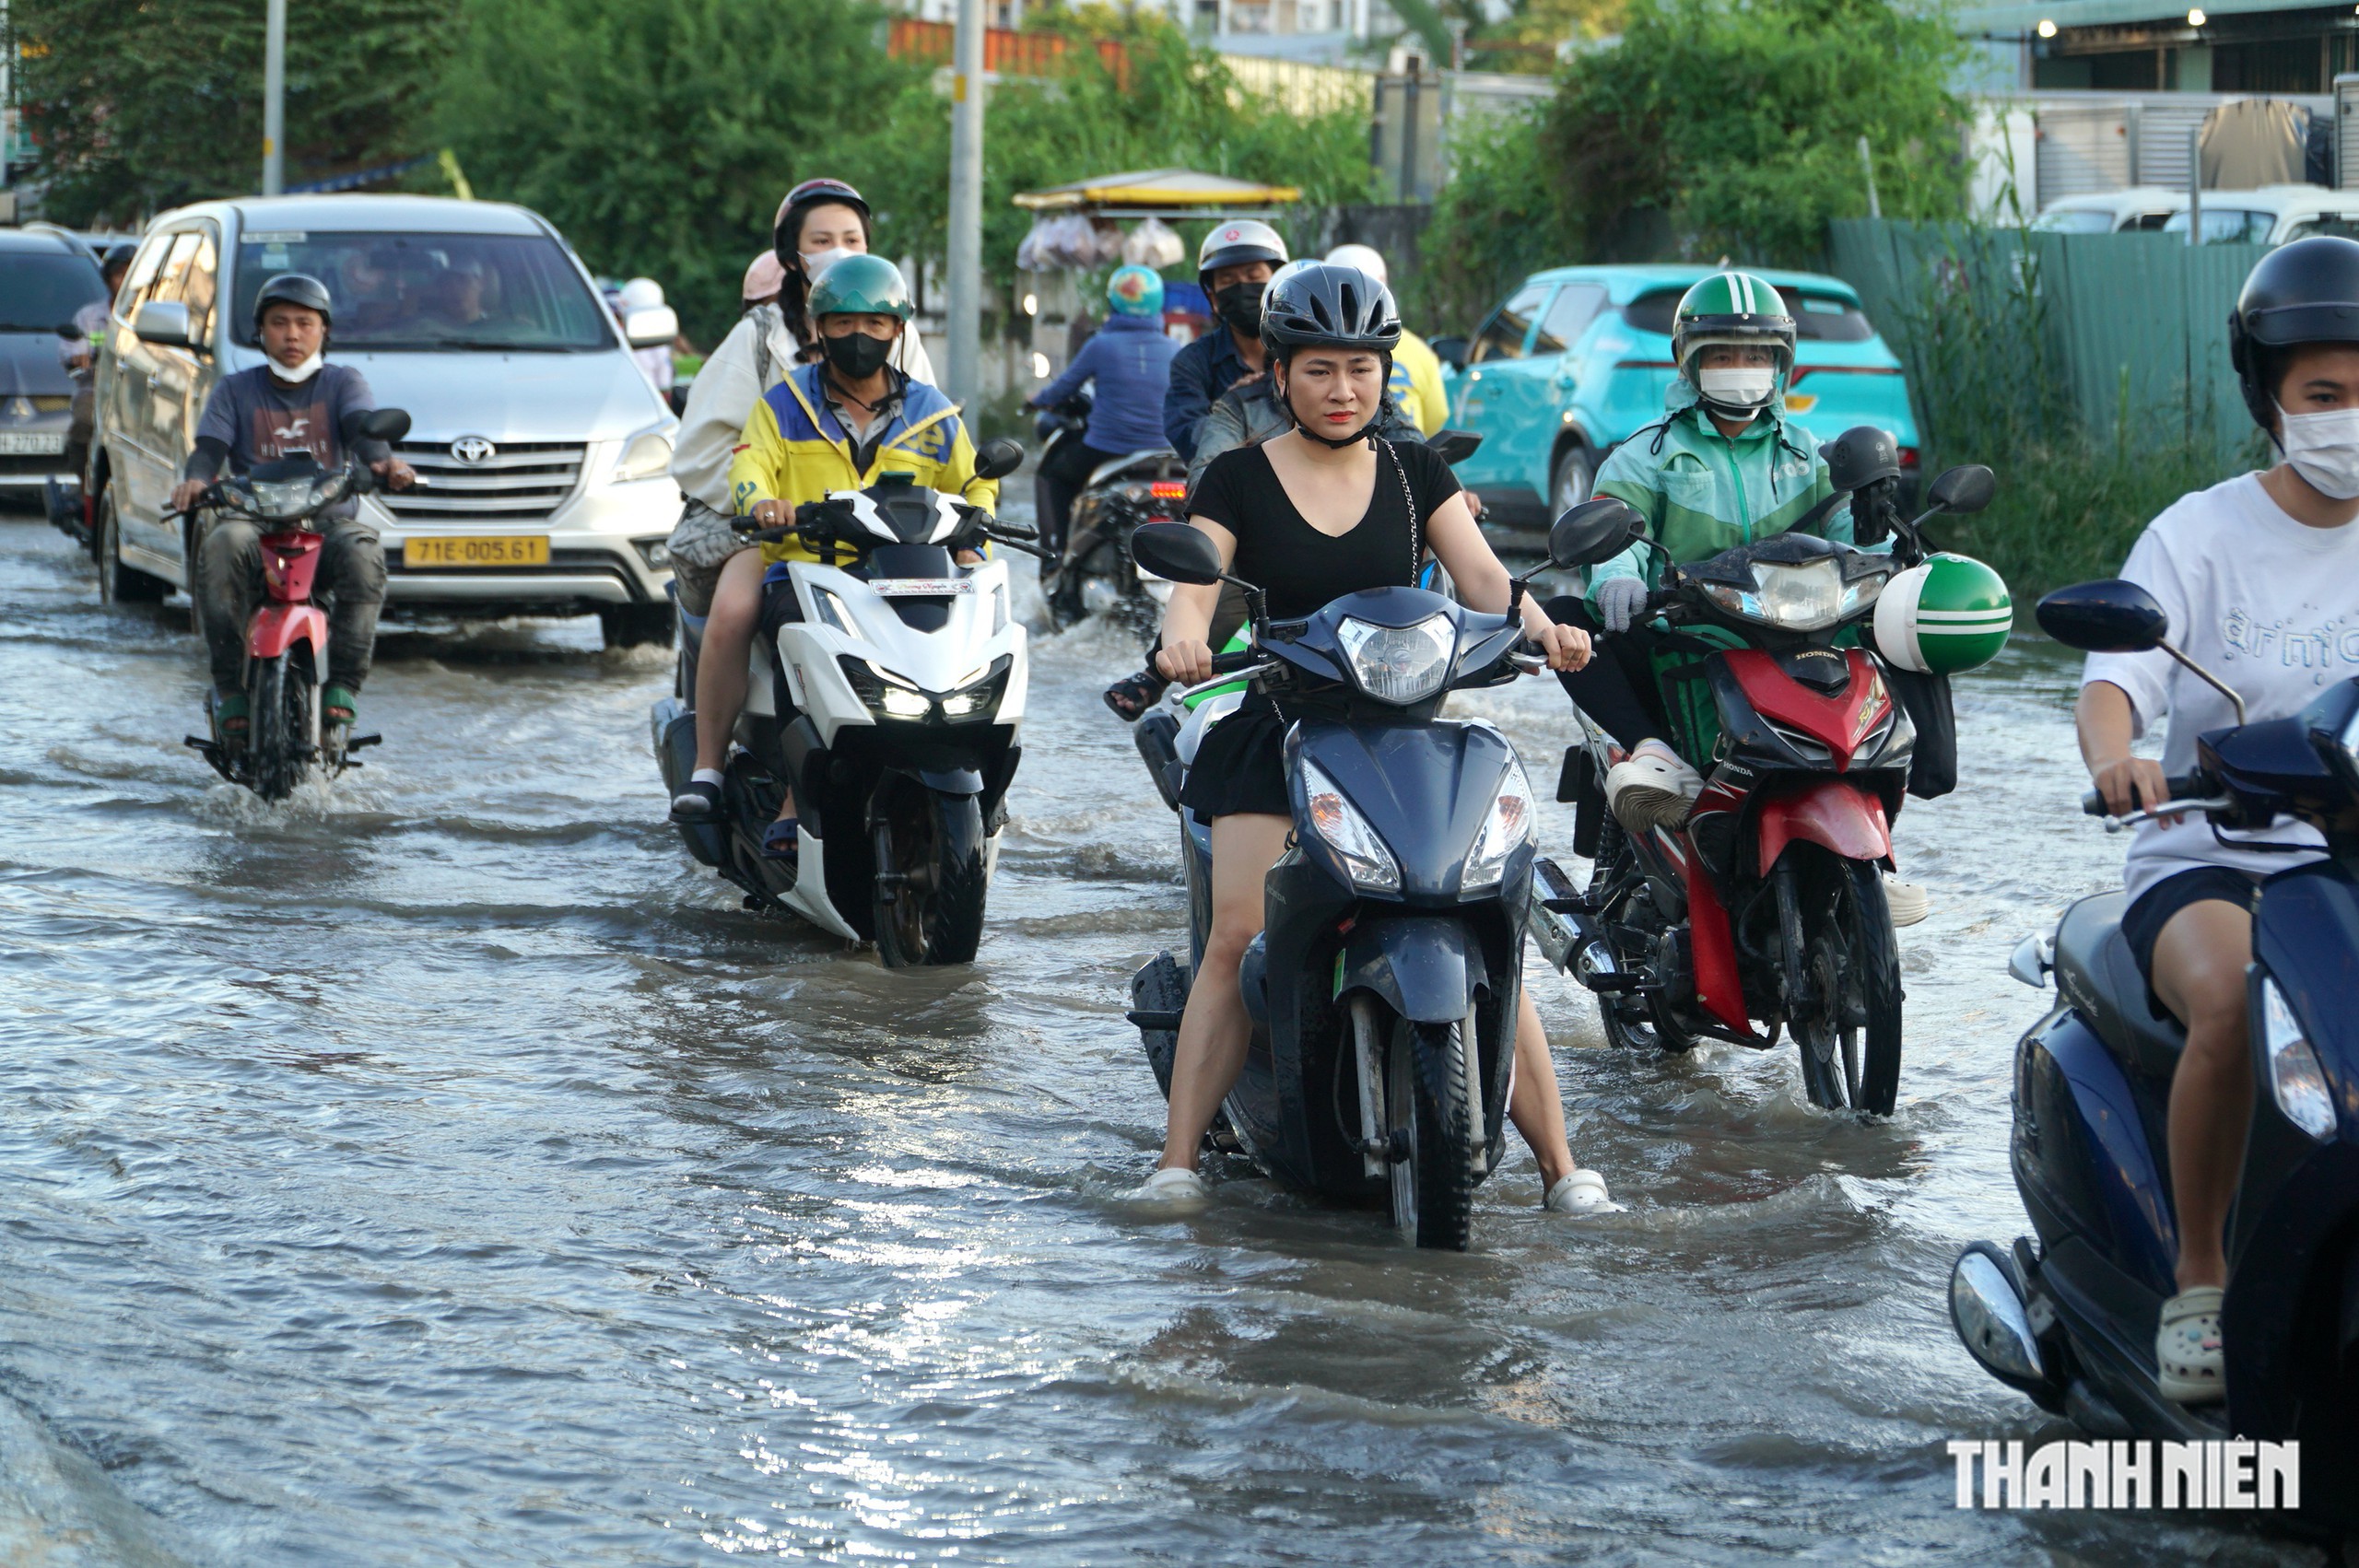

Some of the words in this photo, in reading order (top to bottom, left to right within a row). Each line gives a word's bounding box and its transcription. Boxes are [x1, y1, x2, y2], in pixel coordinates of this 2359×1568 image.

[417, 541, 535, 560] 71E-005.61
[1795, 650, 1839, 661] HONDA
[1722, 760, 1755, 777] HONDA
